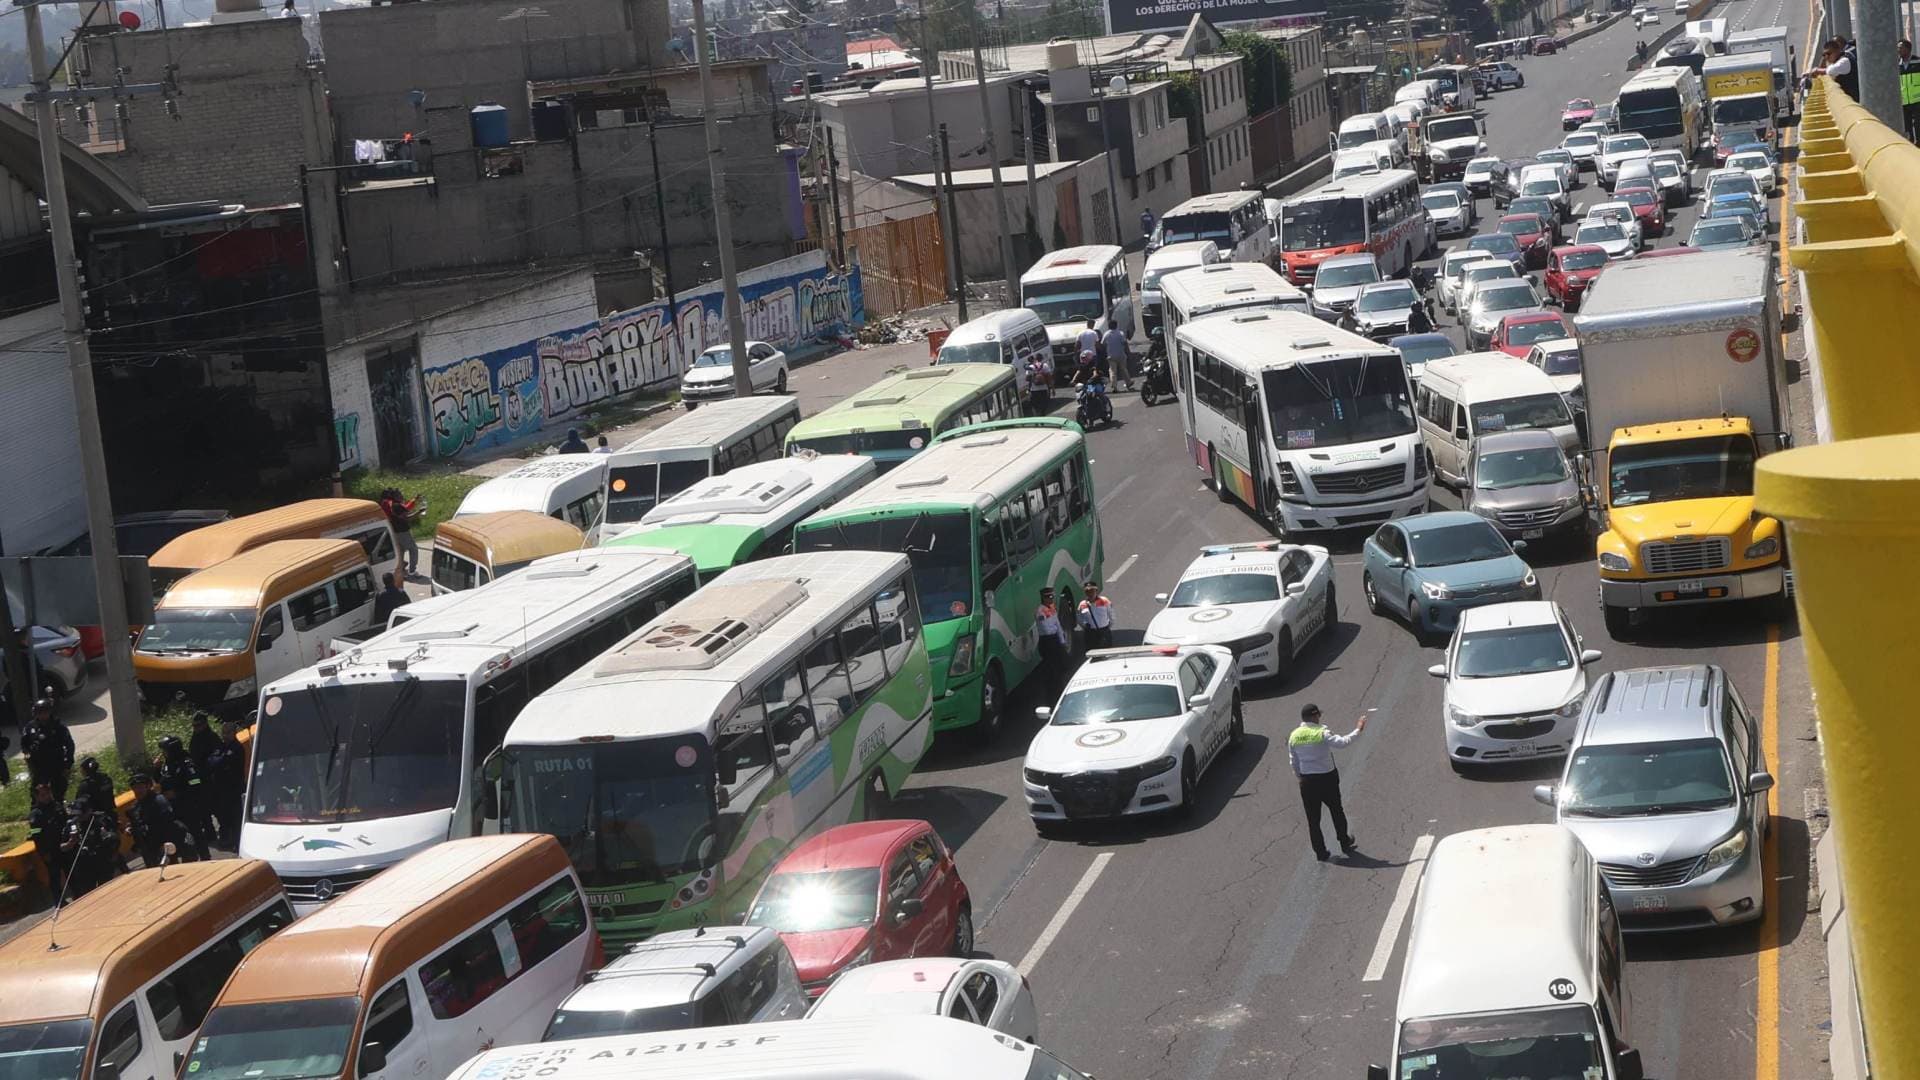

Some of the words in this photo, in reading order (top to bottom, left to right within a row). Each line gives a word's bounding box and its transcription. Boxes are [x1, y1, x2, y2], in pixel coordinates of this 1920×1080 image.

[1136, 7, 1153, 16] LOS
[1203, 1, 1215, 9] DE
[586, 314, 660, 359] MOY
[534, 758, 573, 773] RUTA
[577, 757, 593, 771] 01
[1549, 983, 1575, 995] 190
[755, 1034, 781, 1045] F
